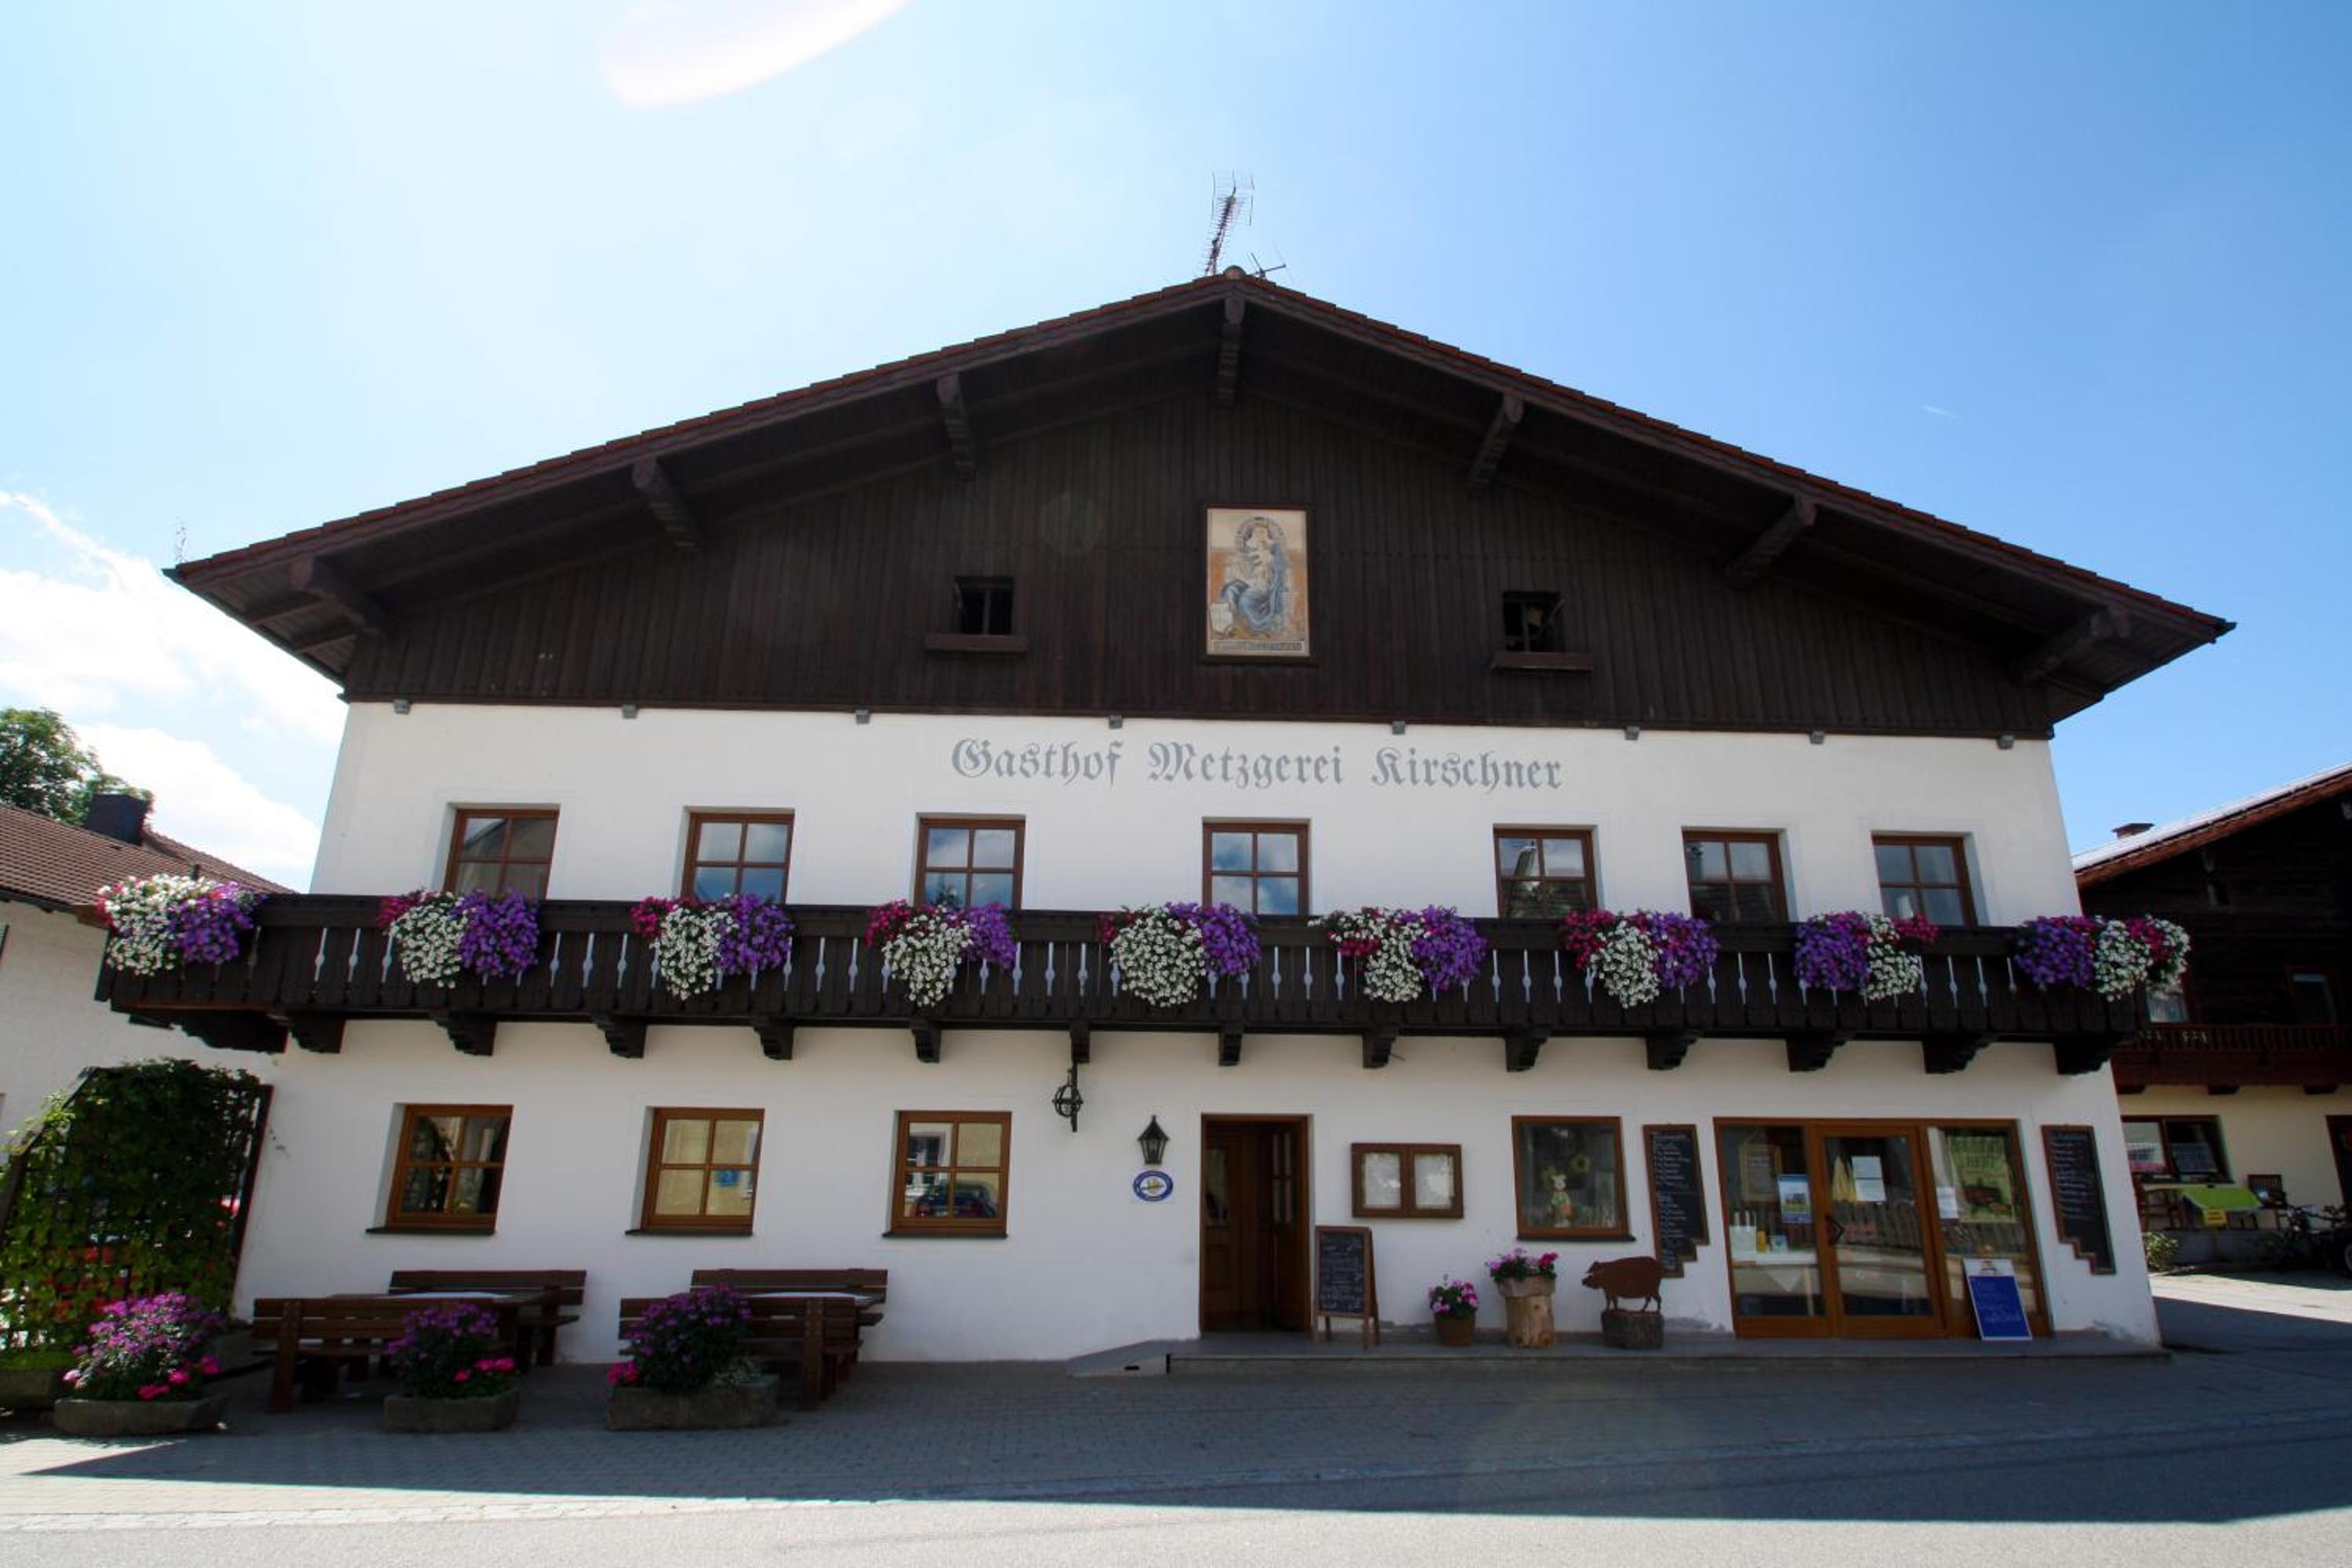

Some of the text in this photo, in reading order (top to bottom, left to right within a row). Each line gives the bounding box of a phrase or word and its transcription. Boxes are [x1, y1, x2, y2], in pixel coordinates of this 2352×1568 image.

[952, 738, 1563, 791] Gasthof Metzgerei Kirschner
